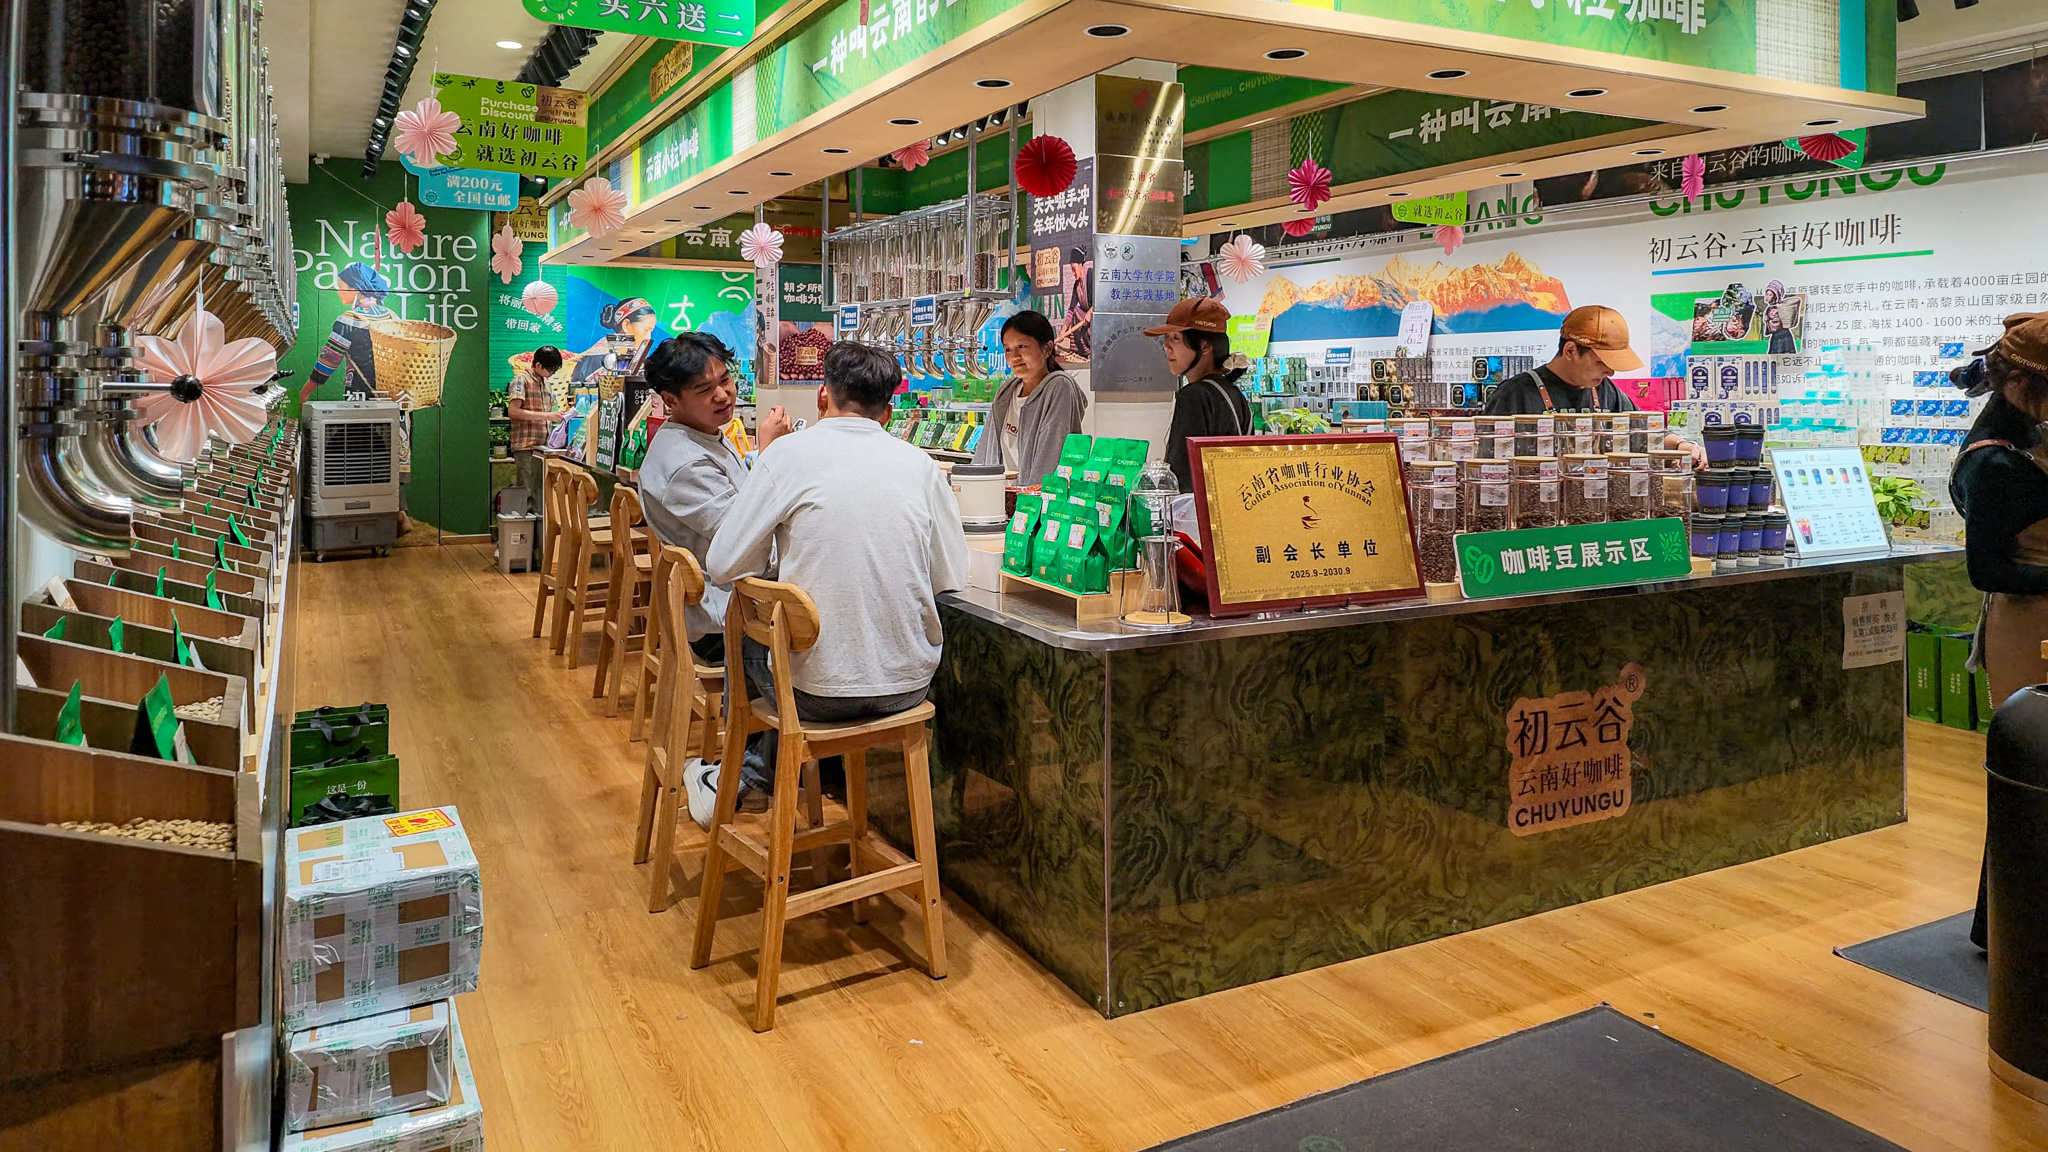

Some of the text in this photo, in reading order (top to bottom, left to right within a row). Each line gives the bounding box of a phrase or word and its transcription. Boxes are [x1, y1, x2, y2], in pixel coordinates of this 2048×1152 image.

[480, 97, 539, 113] Purchase
[480, 107, 536, 122] Discount
[540, 94, 578, 110] 初云谷
[456, 118, 563, 146] 云南好咖啡
[1388, 100, 1572, 145] 一种叫云南
[476, 144, 579, 172] 就选初云谷
[447, 174, 503, 192] 满200元
[1129, 171, 1156, 183] 云南省
[453, 190, 511, 208] 全国包邮
[1412, 204, 1463, 221] 就选初云谷
[1033, 207, 1089, 236] 年年悦心头
[1648, 213, 1902, 264] 初云谷·云南好咖啡
[293, 250, 470, 293] Pasion
[1100, 268, 1175, 283] 云南大学农学院
[1110, 287, 1175, 302] 教学实践基地
[396, 293, 478, 330] Life
[505, 318, 541, 333] 带回家
[1235, 461, 1378, 503] 云南省咖啡行业协会
[1244, 488, 1272, 512] Coffee
[1273, 478, 1326, 494] Association
[1255, 539, 1379, 565] 副会长单位
[1500, 536, 1652, 576] 咖啡豆展示区
[1289, 567, 1351, 579] 2025.9-2030.9
[1513, 696, 1627, 758] 初云谷
[326, 780, 367, 795] 这是一份
[1517, 753, 1624, 797] 云南好咖啡
[1515, 789, 1624, 828] CHUYUNGU
